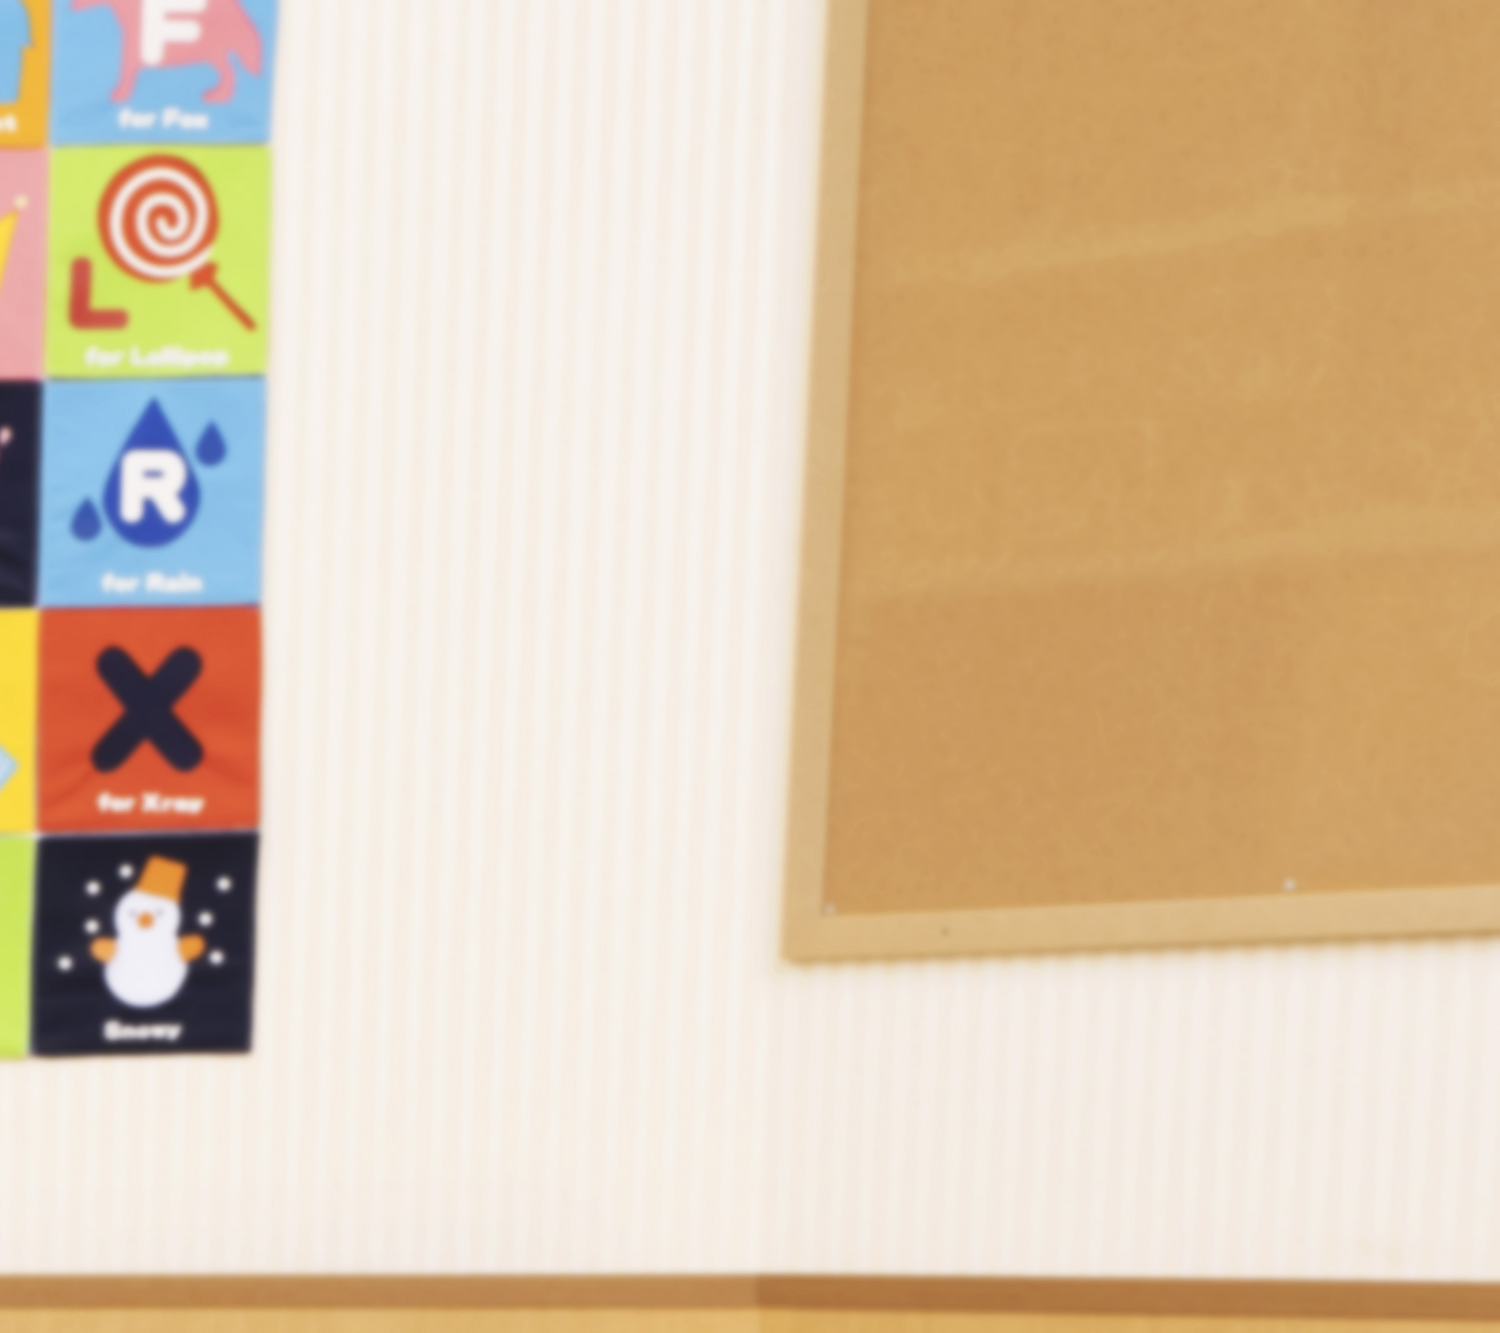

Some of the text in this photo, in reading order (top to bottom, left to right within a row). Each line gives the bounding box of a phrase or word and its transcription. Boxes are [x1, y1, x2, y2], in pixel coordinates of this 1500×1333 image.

[141, 0, 203, 67] F
[119, 109, 207, 130] for Fox
[68, 257, 128, 329] L
[86, 347, 124, 369] for
[120, 449, 188, 524] R
[102, 573, 202, 594] for Rain
[90, 645, 205, 773] X
[98, 793, 135, 815] for
[104, 1020, 182, 1043] Snowy
